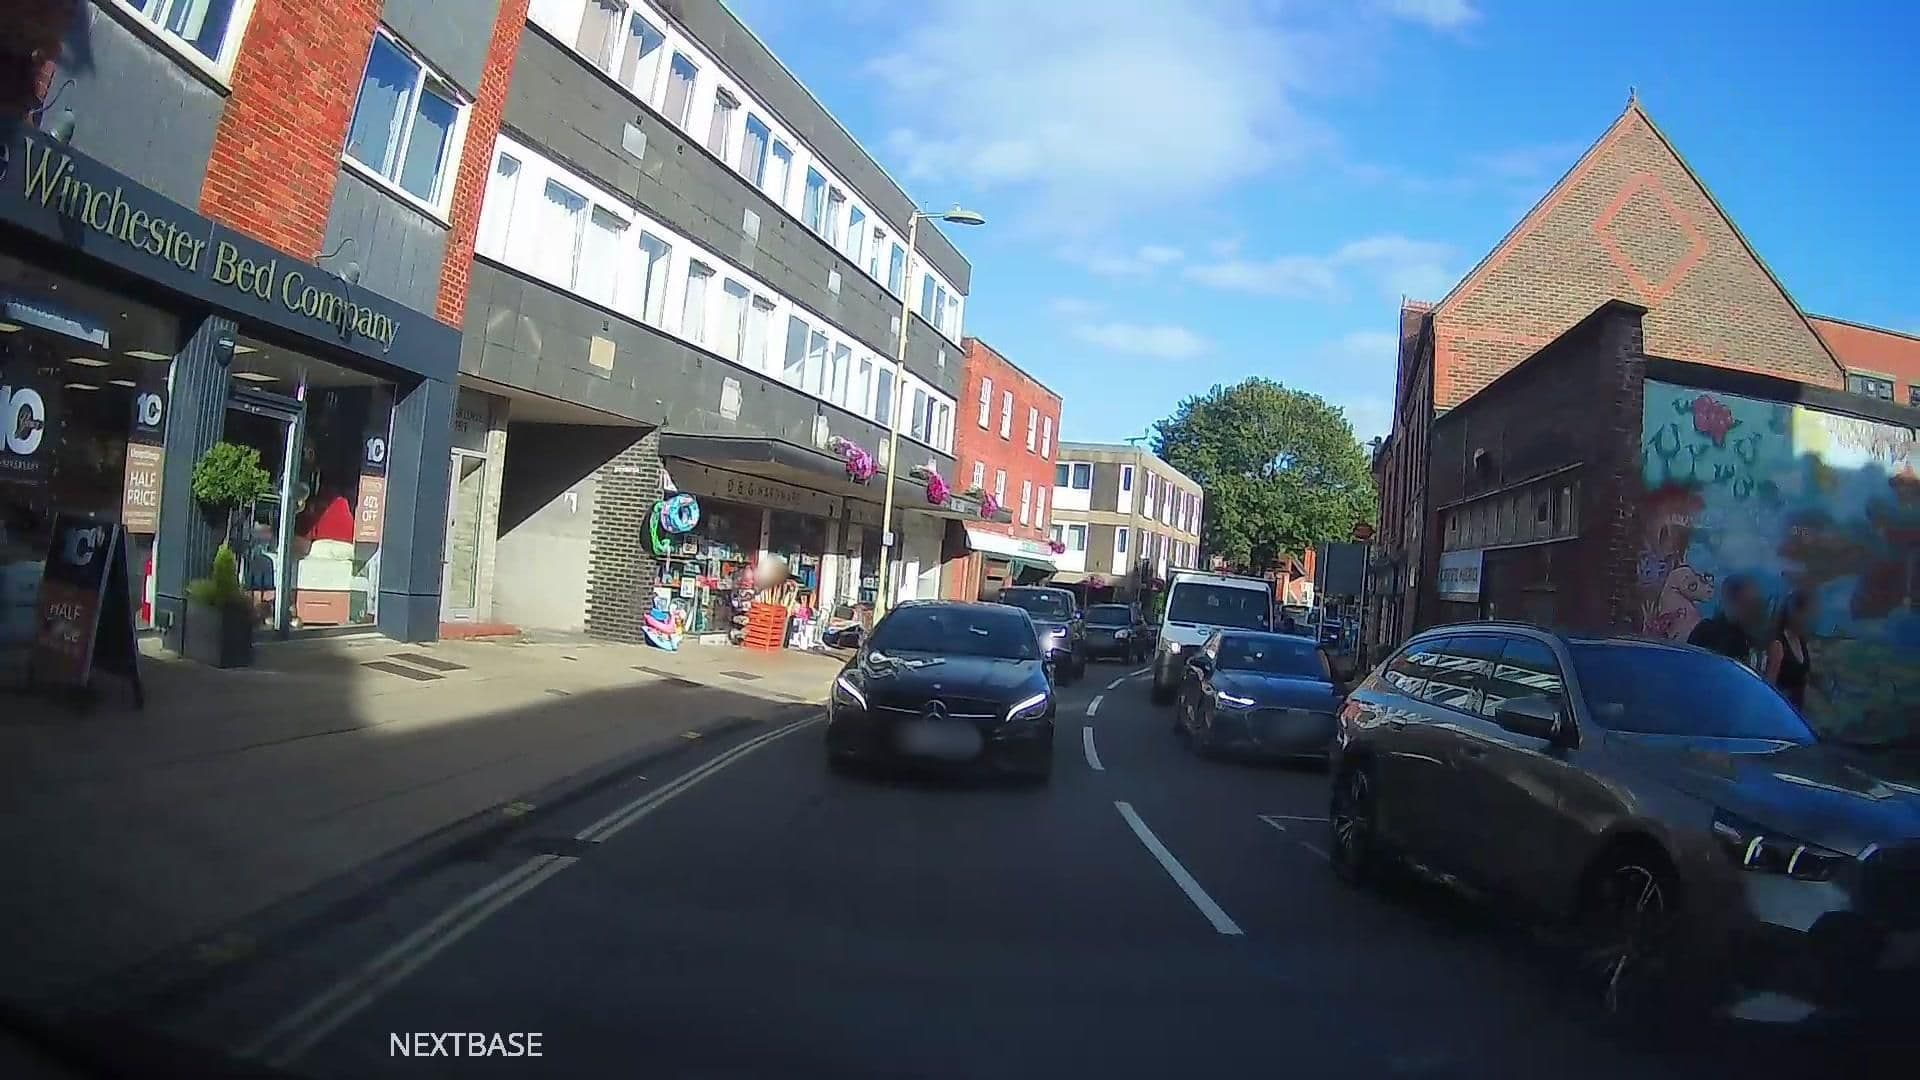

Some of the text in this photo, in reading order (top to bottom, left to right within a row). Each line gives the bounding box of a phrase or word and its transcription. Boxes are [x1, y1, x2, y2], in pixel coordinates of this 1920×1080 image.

[24, 136, 205, 273] Winchester
[211, 240, 277, 301] Bed
[281, 271, 400, 354] Company
[129, 471, 157, 488] HALF
[127, 489, 157, 506] PRICE
[362, 510, 378, 522] OFF
